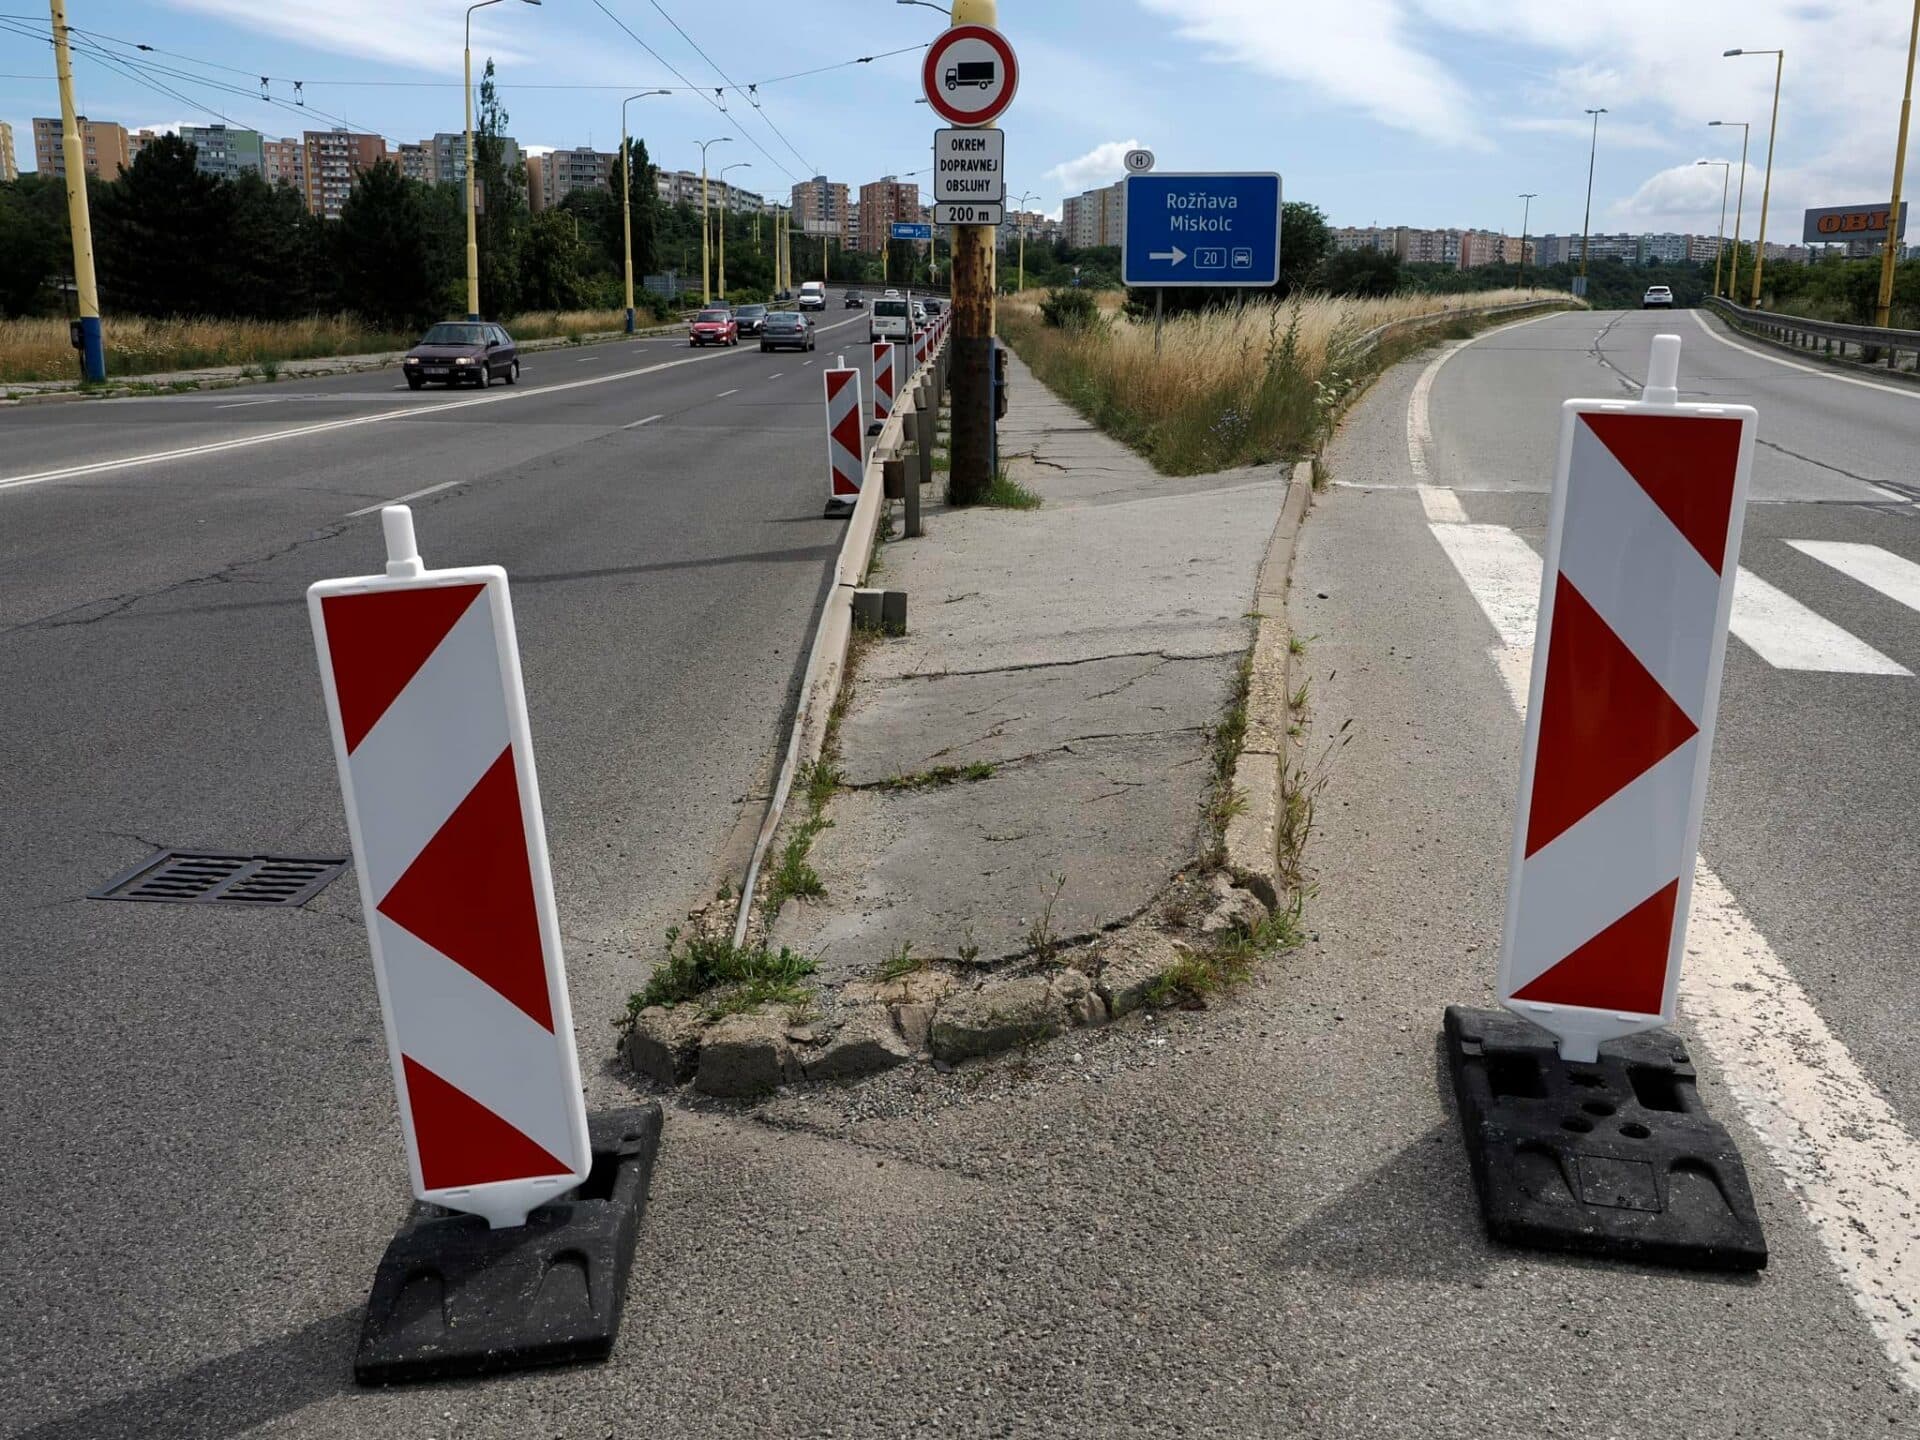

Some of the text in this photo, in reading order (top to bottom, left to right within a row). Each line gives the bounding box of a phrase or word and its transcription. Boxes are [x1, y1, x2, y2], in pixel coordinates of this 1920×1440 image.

[951, 138, 985, 151] OKREM
[940, 159, 998, 172] DOPRAVNEJ
[1135, 155, 1143, 166] H
[946, 179, 990, 192] OBSLUHY
[1166, 192, 1238, 209] Rožňava
[949, 207, 989, 222] 200 m
[1170, 214, 1233, 231] Miskolc
[1817, 211, 1889, 233] OBI
[1203, 251, 1218, 265] 20
